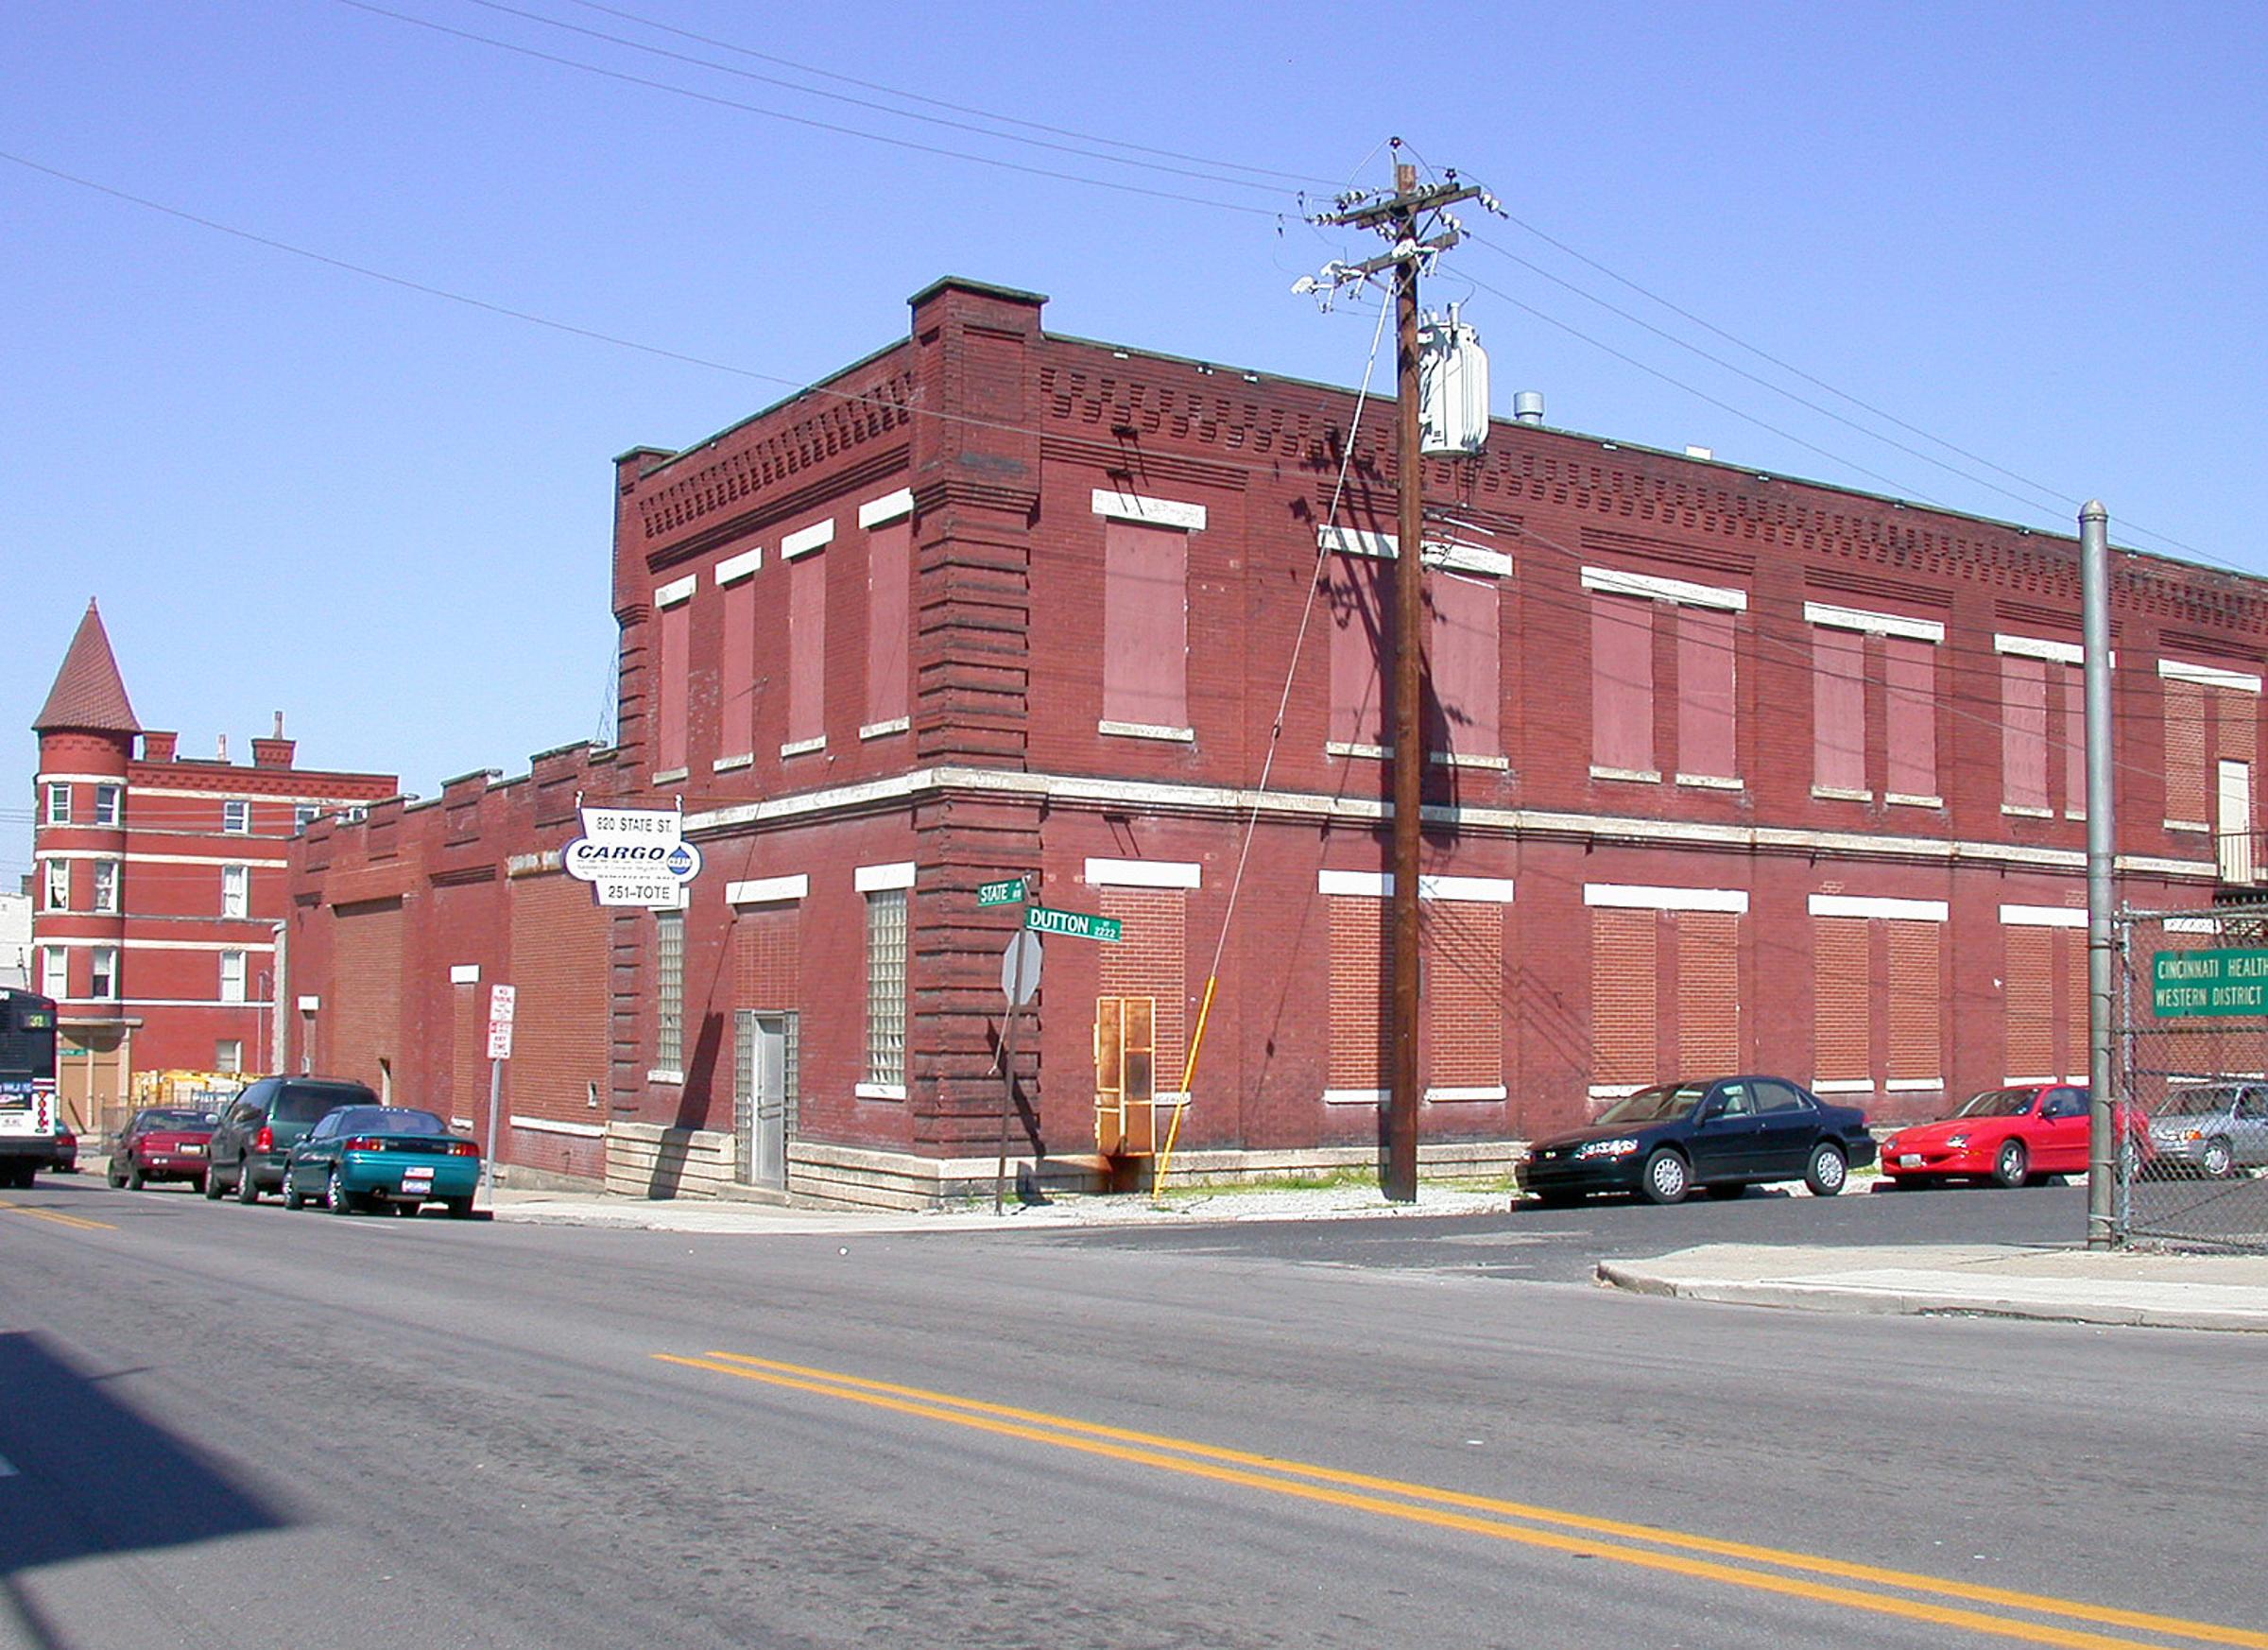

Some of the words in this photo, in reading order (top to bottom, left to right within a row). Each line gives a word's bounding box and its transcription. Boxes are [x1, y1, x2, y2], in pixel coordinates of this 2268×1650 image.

[619, 817, 652, 833] STATE
[577, 845, 665, 860] CARGO
[608, 885, 670, 900] 251-TOTE
[981, 884, 1008, 902] STATE
[1031, 908, 1089, 934] DUTTON
[1094, 926, 1116, 938] 2222
[2157, 959, 2219, 979] CINCINNATI
[2156, 988, 2207, 1006] WESTERN
[2212, 986, 2262, 1006] DISTRICT
